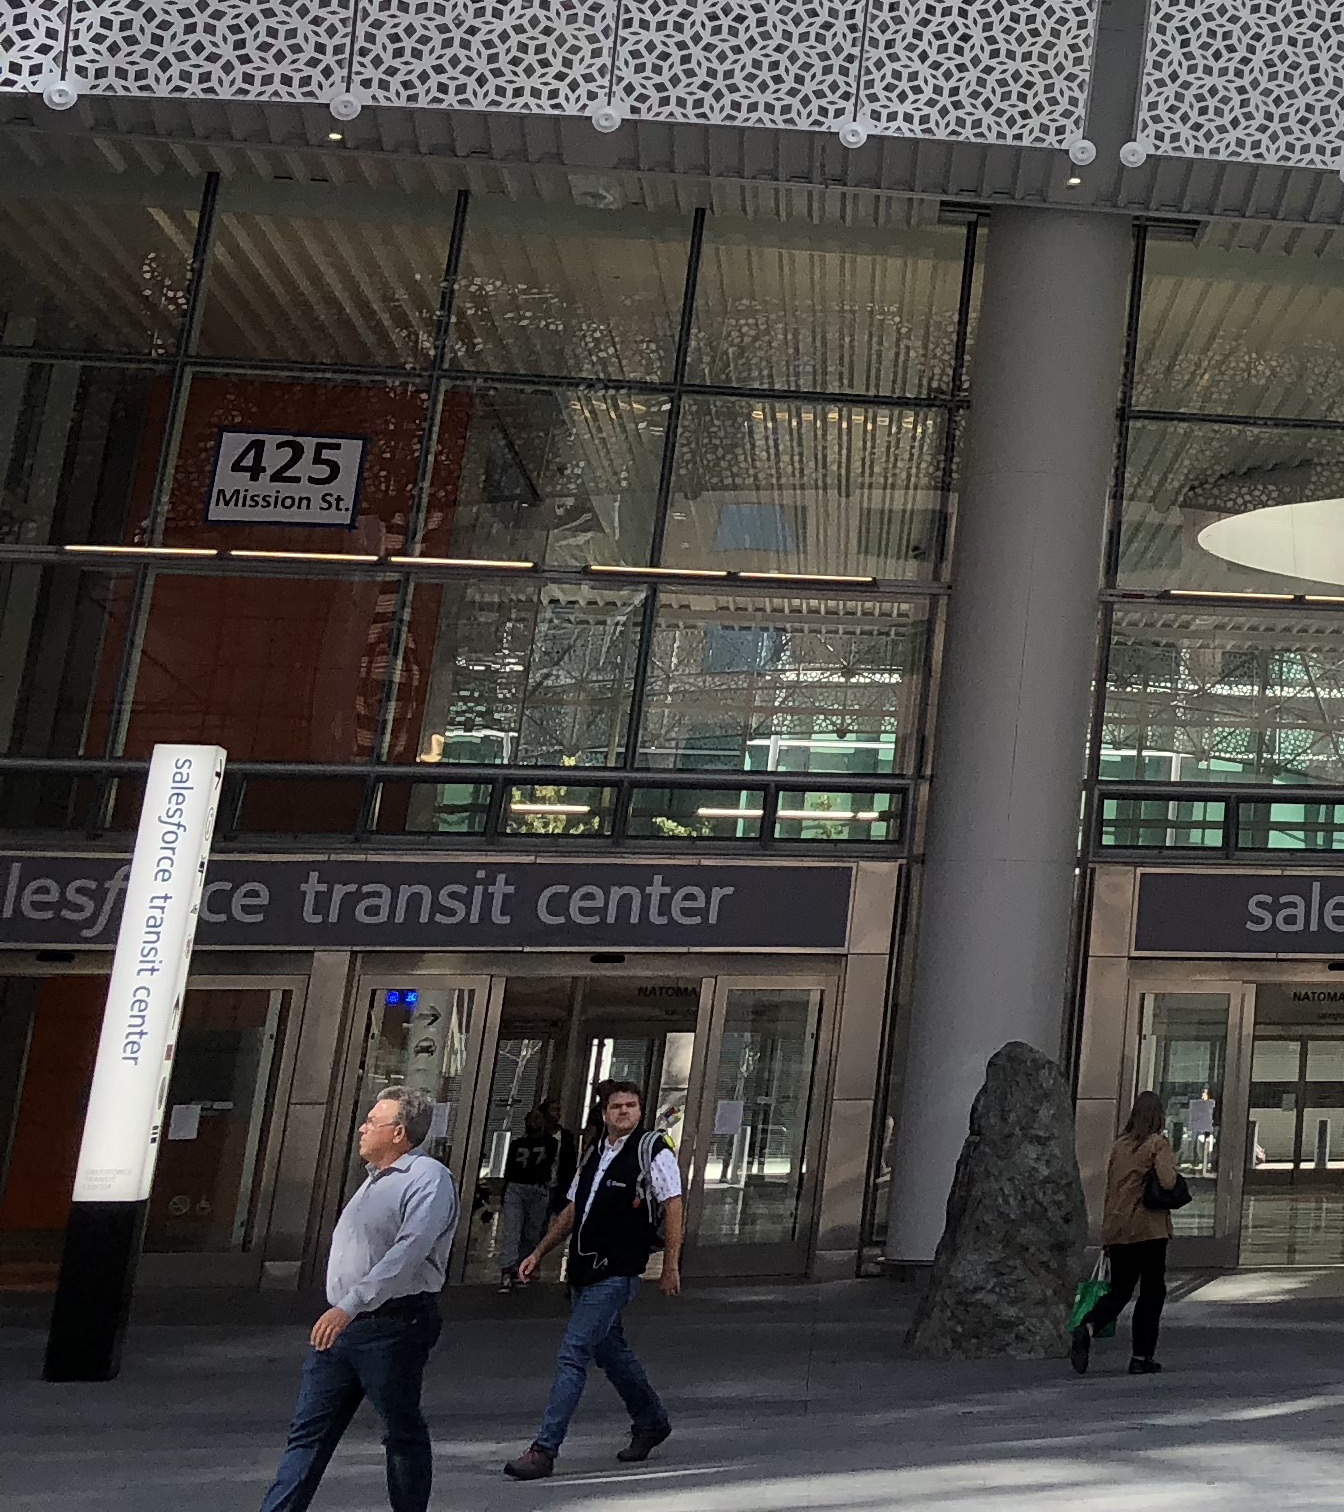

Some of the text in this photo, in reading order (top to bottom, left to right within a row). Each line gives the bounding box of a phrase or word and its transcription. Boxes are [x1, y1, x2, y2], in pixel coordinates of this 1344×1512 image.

[231, 439, 342, 486] 425
[215, 488, 350, 512] Mission St.
[1, 862, 735, 938] lesfce transit center
[121, 758, 194, 1066] salesforce transit center
[637, 986, 698, 997] NATOMA
